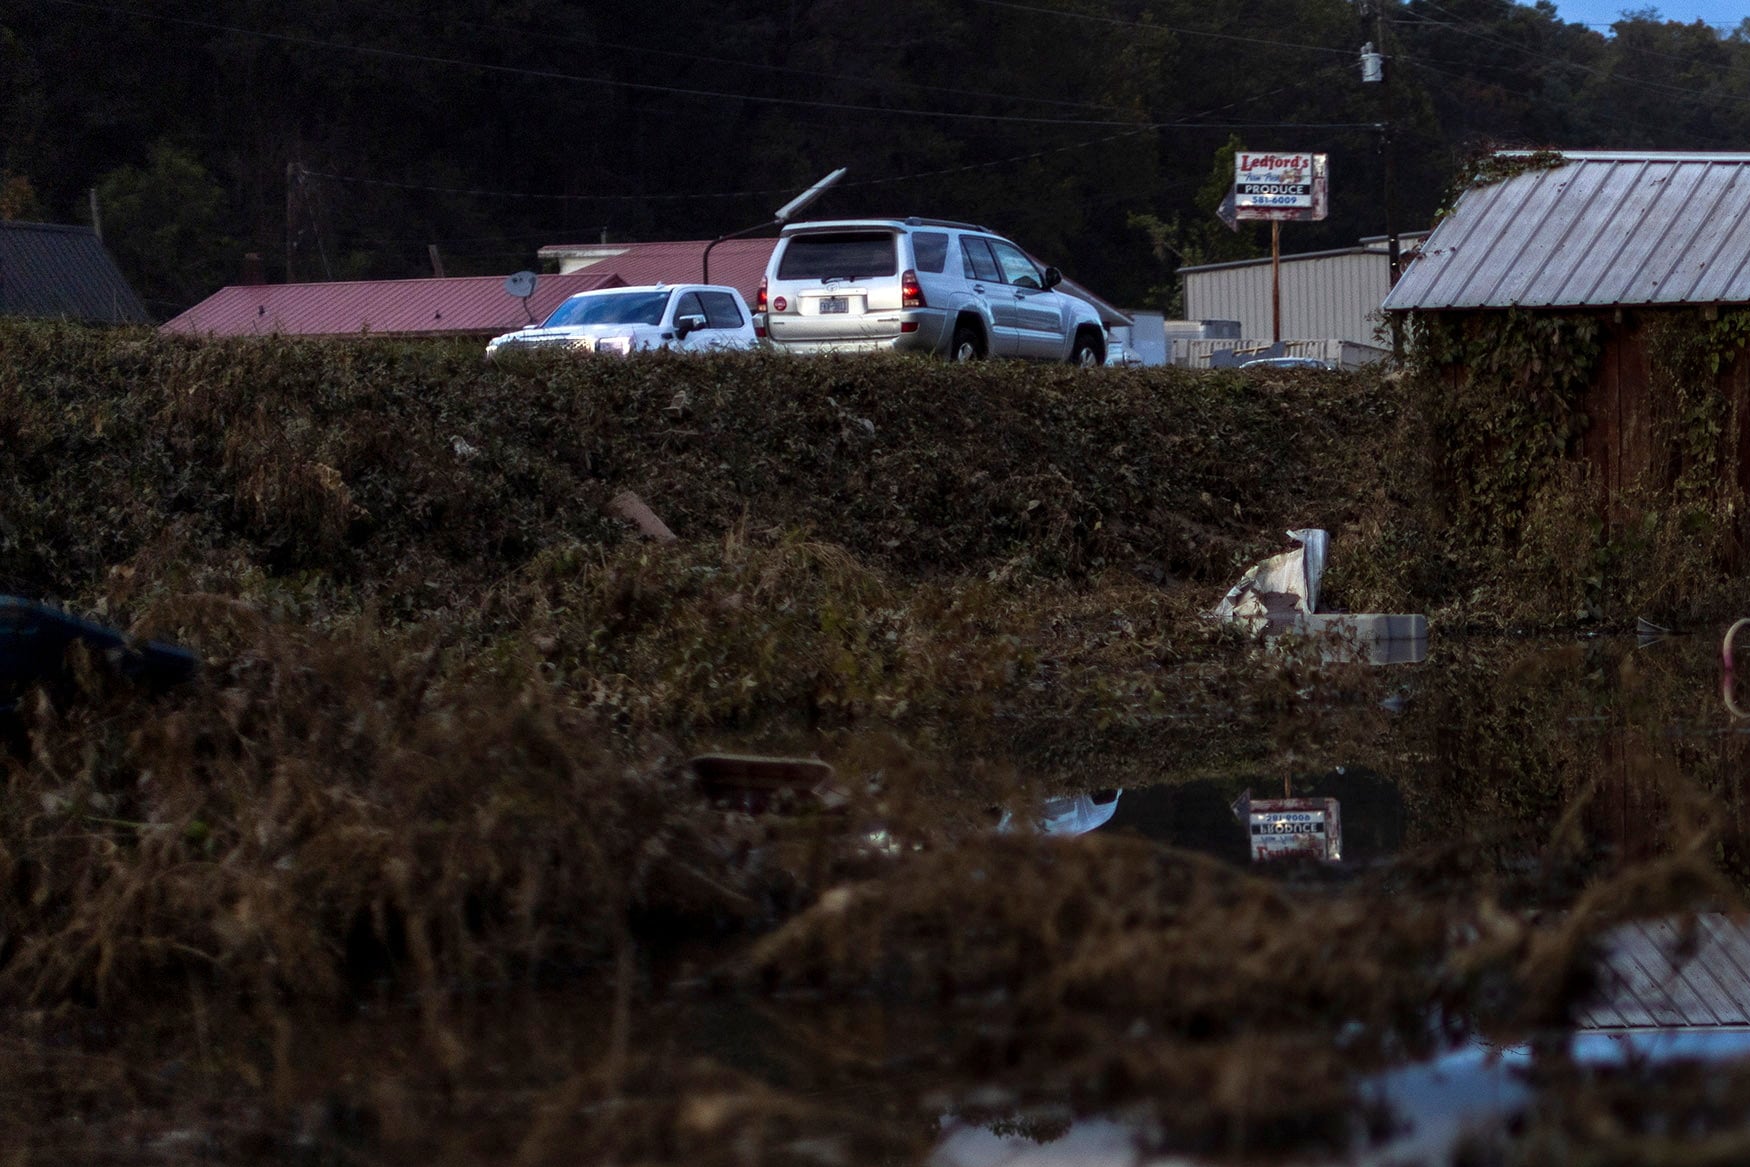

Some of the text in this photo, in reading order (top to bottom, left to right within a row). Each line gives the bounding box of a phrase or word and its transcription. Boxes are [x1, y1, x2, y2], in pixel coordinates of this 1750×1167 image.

[1240, 155, 1309, 171] Ledford's
[1245, 185, 1304, 194] PRODUCE
[1252, 196, 1297, 204] 581-6009
